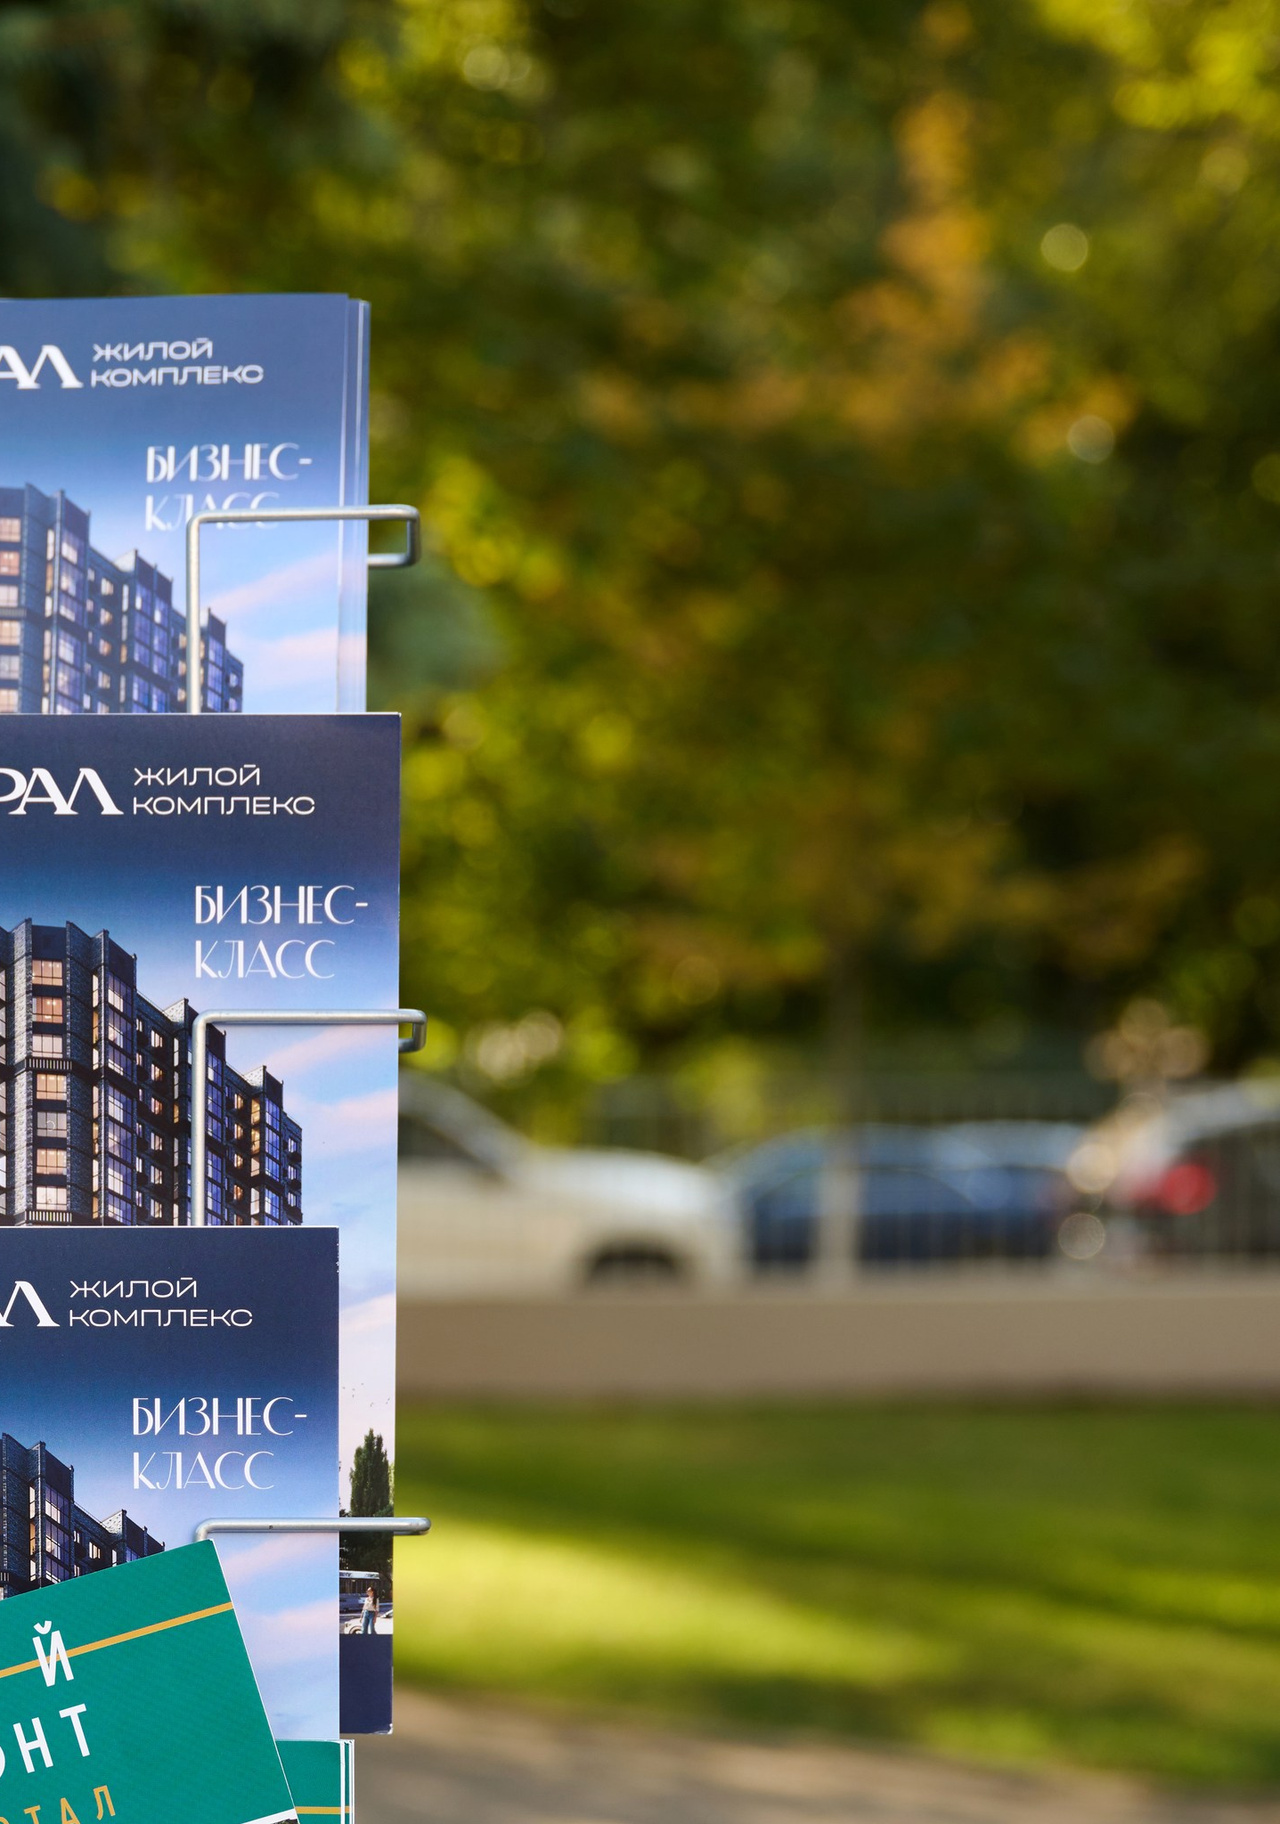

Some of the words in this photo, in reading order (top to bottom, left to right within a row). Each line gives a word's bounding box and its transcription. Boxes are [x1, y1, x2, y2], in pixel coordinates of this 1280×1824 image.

[92, 337, 214, 362] ЖИЛОЙ
[90, 364, 265, 388] КОМПЛЕКС
[146, 442, 312, 483] БИЗНЕС-
[133, 763, 261, 787] ЖИЛОЙ
[132, 795, 316, 816] КОМПЛЕКС
[194, 884, 369, 925] БИЗНЕС-
[195, 939, 335, 978] КЛАСС
[69, 1276, 197, 1299] ЖИЛОЙ
[69, 1308, 253, 1328] КОМПЛЕКС
[132, 1396, 308, 1437] БИЗНЕС-
[133, 1450, 274, 1490] КЛАСС
